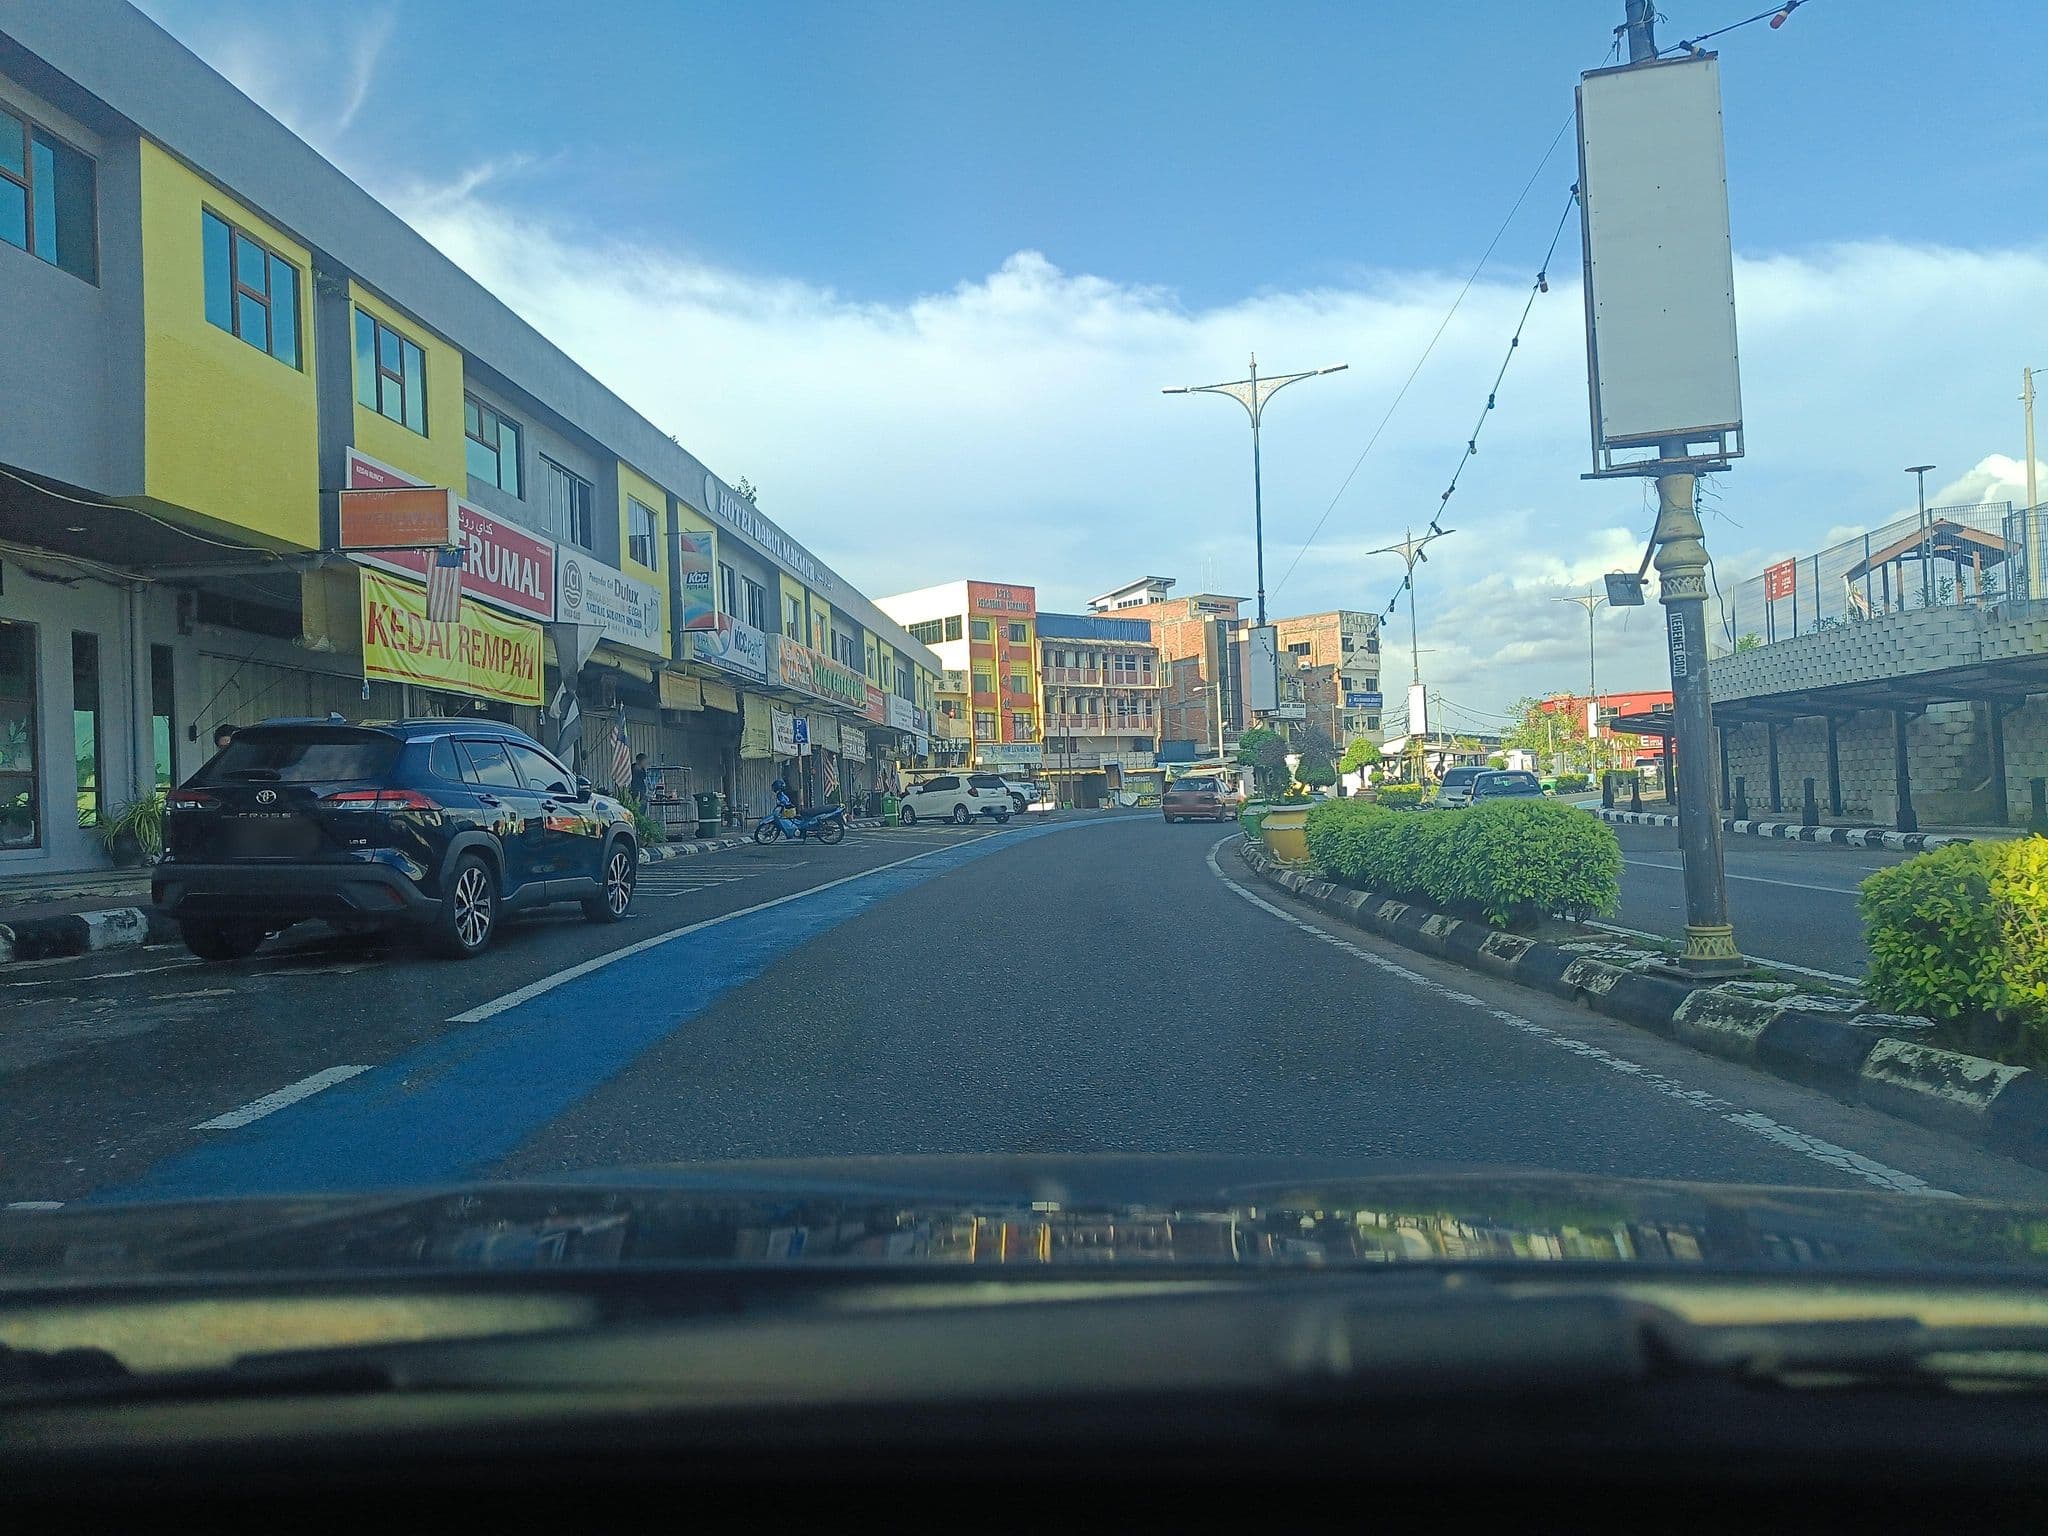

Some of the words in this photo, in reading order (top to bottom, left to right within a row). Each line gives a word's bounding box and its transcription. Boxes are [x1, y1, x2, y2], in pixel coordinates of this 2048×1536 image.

[718, 490, 754, 537] HOTEL
[754, 519, 782, 557] DARUL
[782, 540, 815, 582] MAKMUR
[458, 529, 545, 601] ERUMAL
[566, 567, 581, 590] ICI
[688, 571, 708, 584] KCC
[614, 578, 639, 606] Dulux
[367, 601, 452, 660] KEDAI
[458, 623, 534, 680] REMPAH
[1671, 614, 1686, 676] KEBEHET.COM
[796, 719, 802, 729] P
